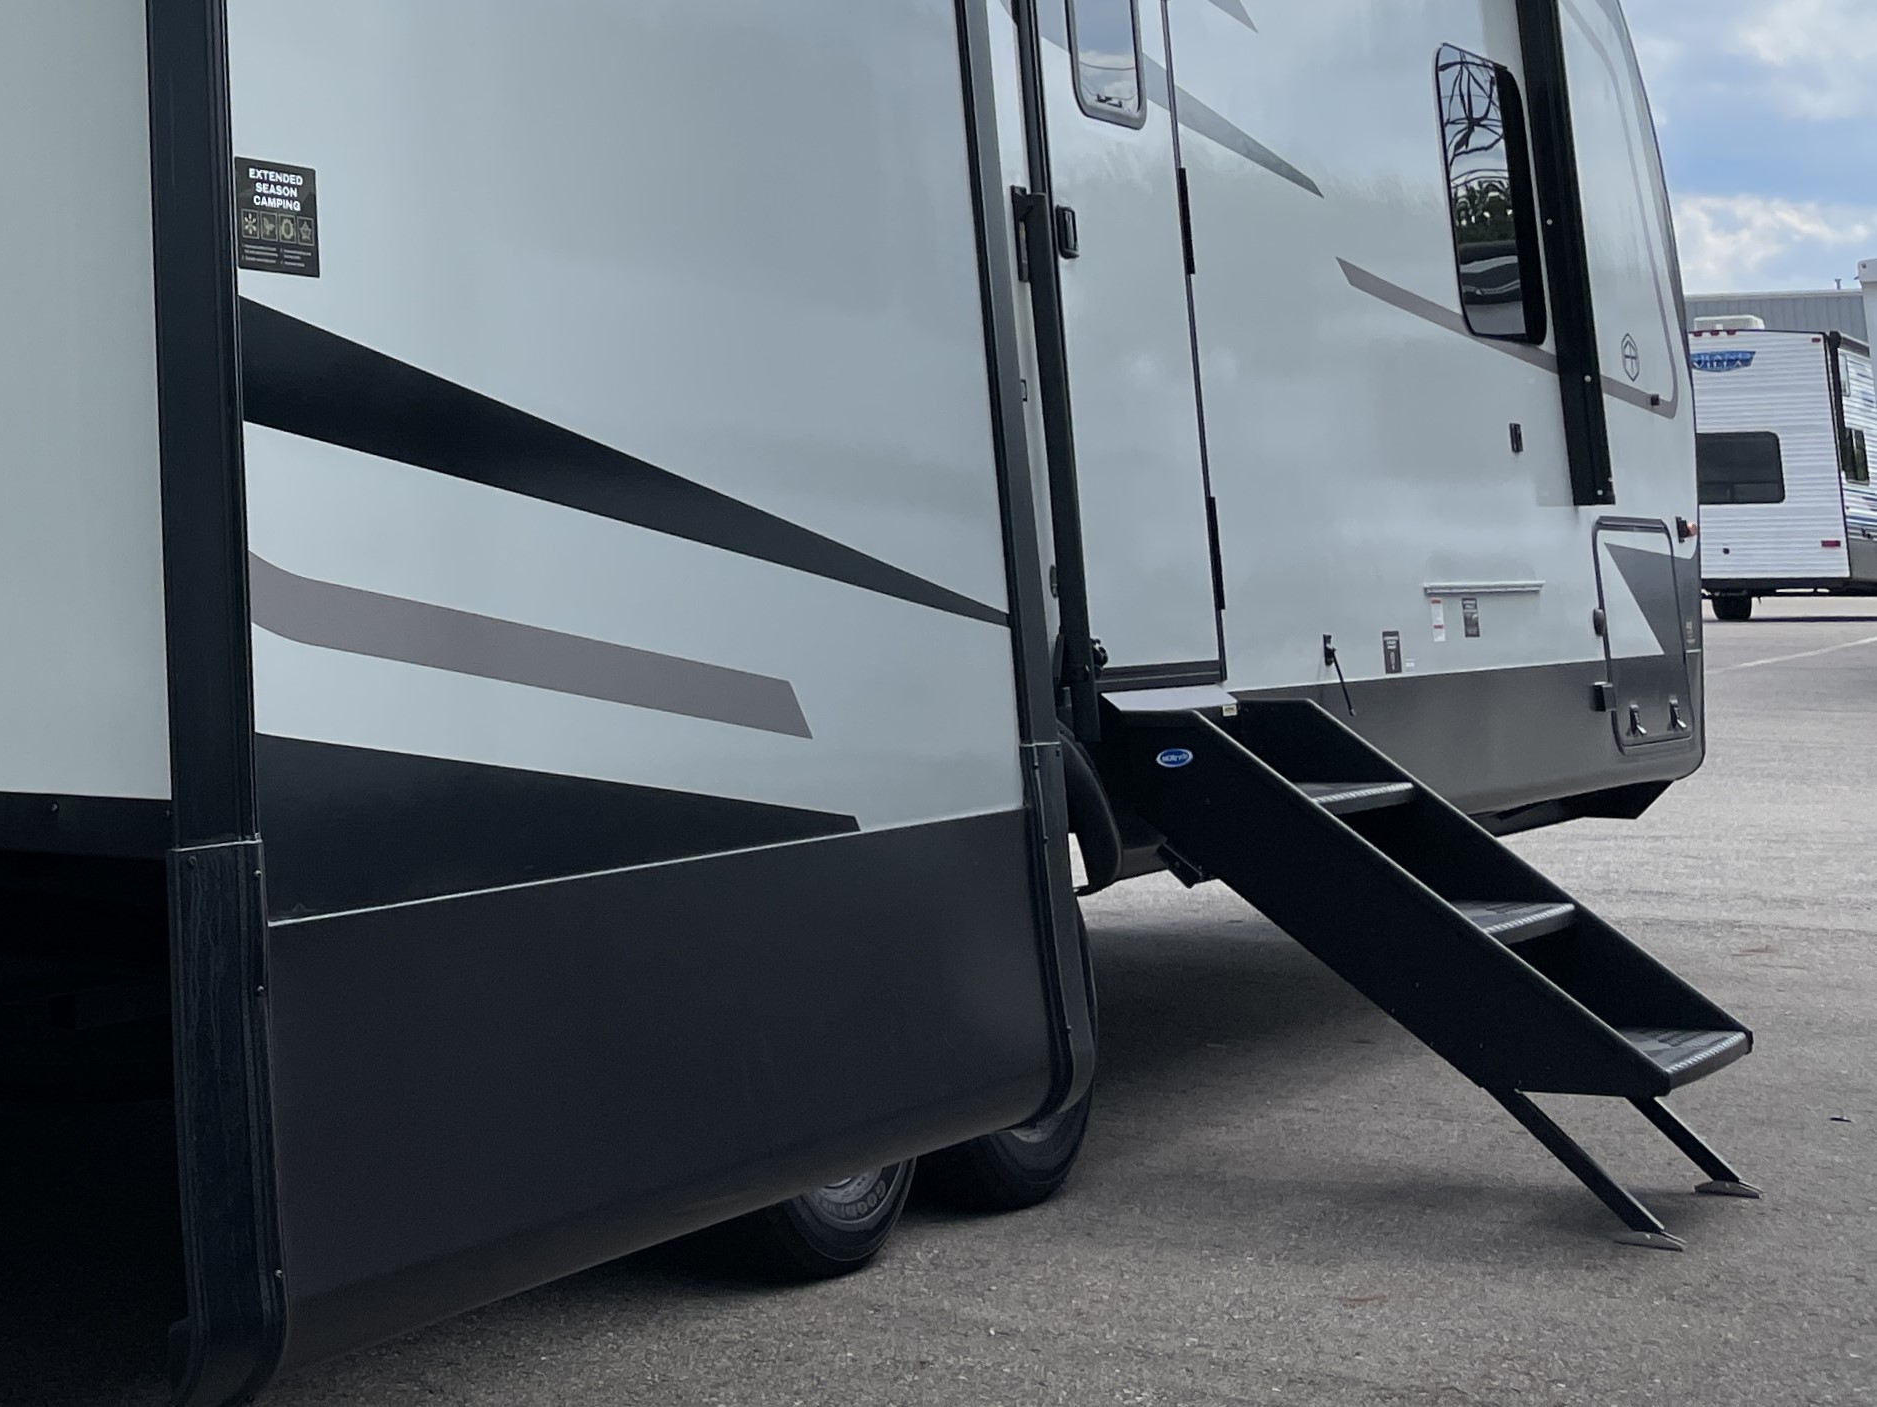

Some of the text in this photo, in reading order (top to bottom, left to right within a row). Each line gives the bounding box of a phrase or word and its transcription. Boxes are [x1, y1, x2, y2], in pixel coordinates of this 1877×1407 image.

[248, 167, 303, 186] EXTENDED
[255, 182, 298, 198] SEASON
[253, 195, 301, 211] CAMPING
